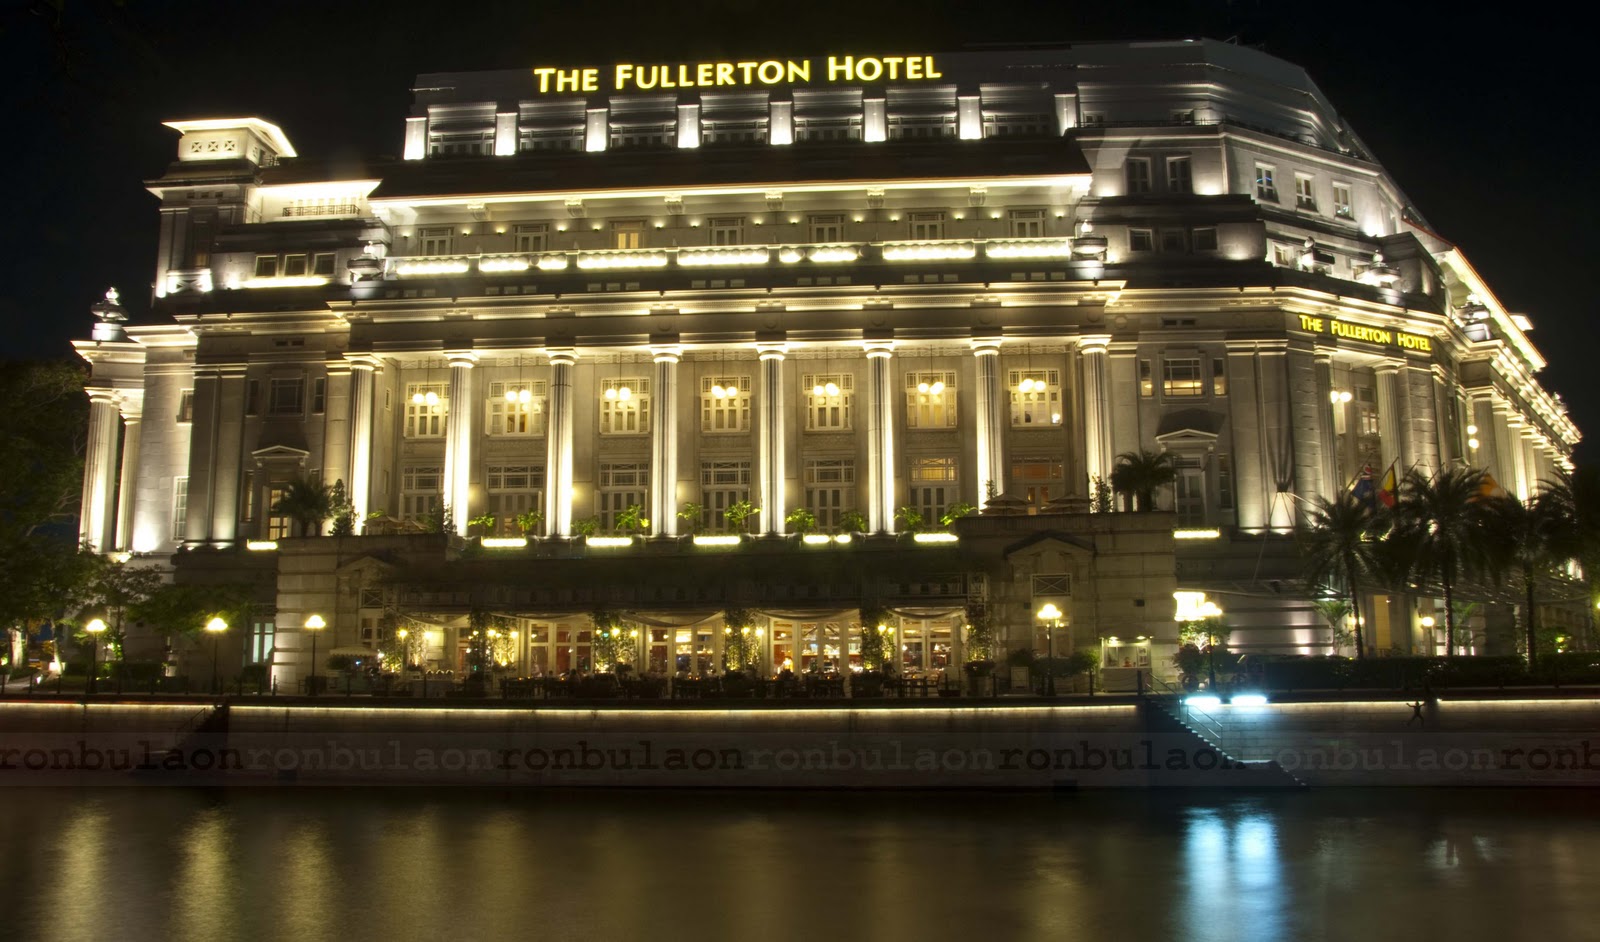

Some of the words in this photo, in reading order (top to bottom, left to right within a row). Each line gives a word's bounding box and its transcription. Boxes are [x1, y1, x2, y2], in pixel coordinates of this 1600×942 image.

[533, 67, 599, 93] THE
[615, 57, 811, 90] FULLERTON
[828, 55, 942, 82] HOTEL
[1299, 314, 1323, 332] THE
[1330, 320, 1391, 344] FULLERTON
[1397, 332, 1432, 351] HOTEL
